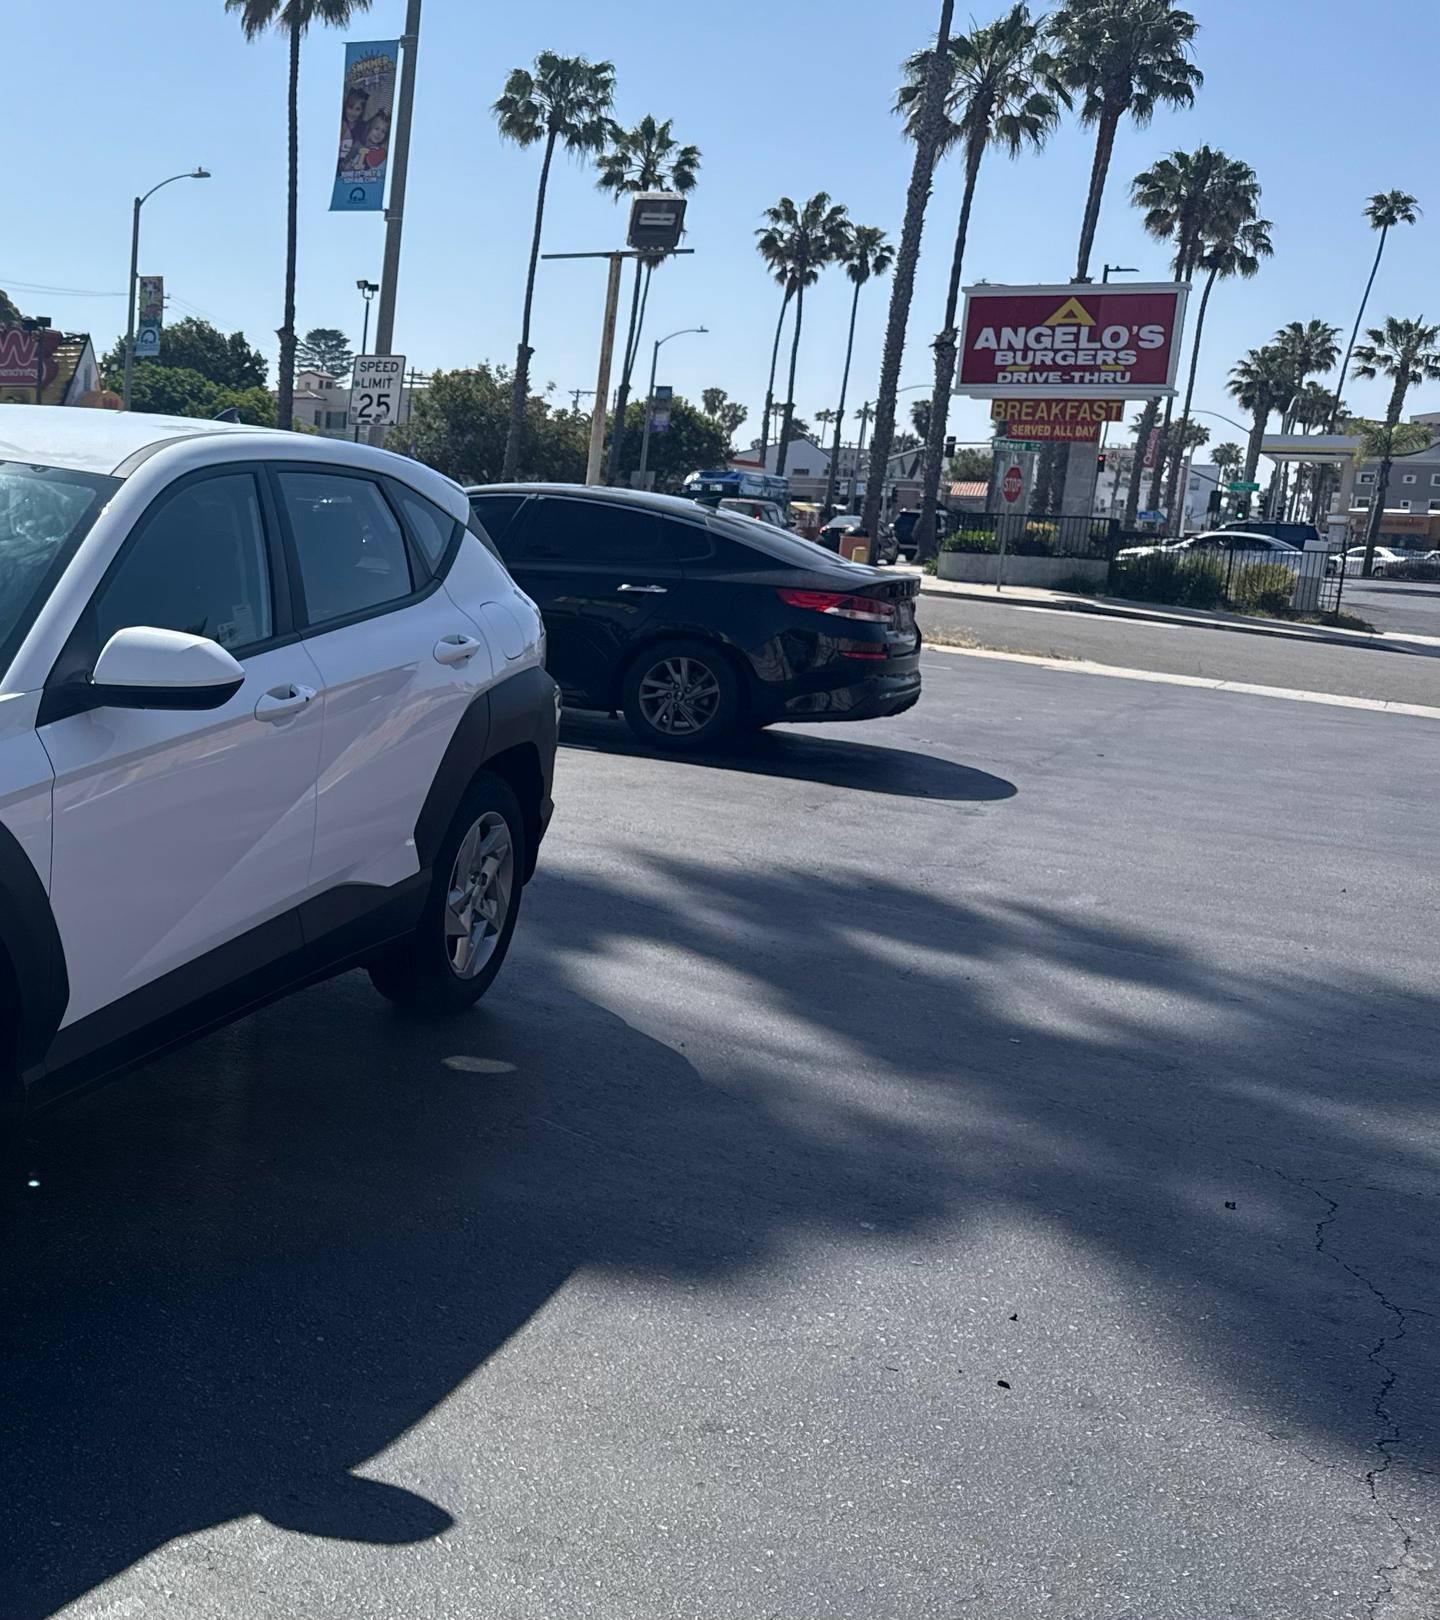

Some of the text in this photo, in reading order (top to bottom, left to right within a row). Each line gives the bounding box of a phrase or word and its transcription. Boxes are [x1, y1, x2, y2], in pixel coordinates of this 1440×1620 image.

[973, 325, 1165, 350] ANGELO'S
[994, 350, 1137, 366] BURGERS
[360, 361, 399, 373] SPEED
[361, 377, 393, 389] LIMIT
[996, 371, 1131, 384] DRIVE-THRU
[358, 393, 391, 419] 25
[992, 401, 1122, 421] BREAKFAST
[1012, 424, 1096, 437] SERVED ALL DAY
[1003, 478, 1021, 493] STOP
